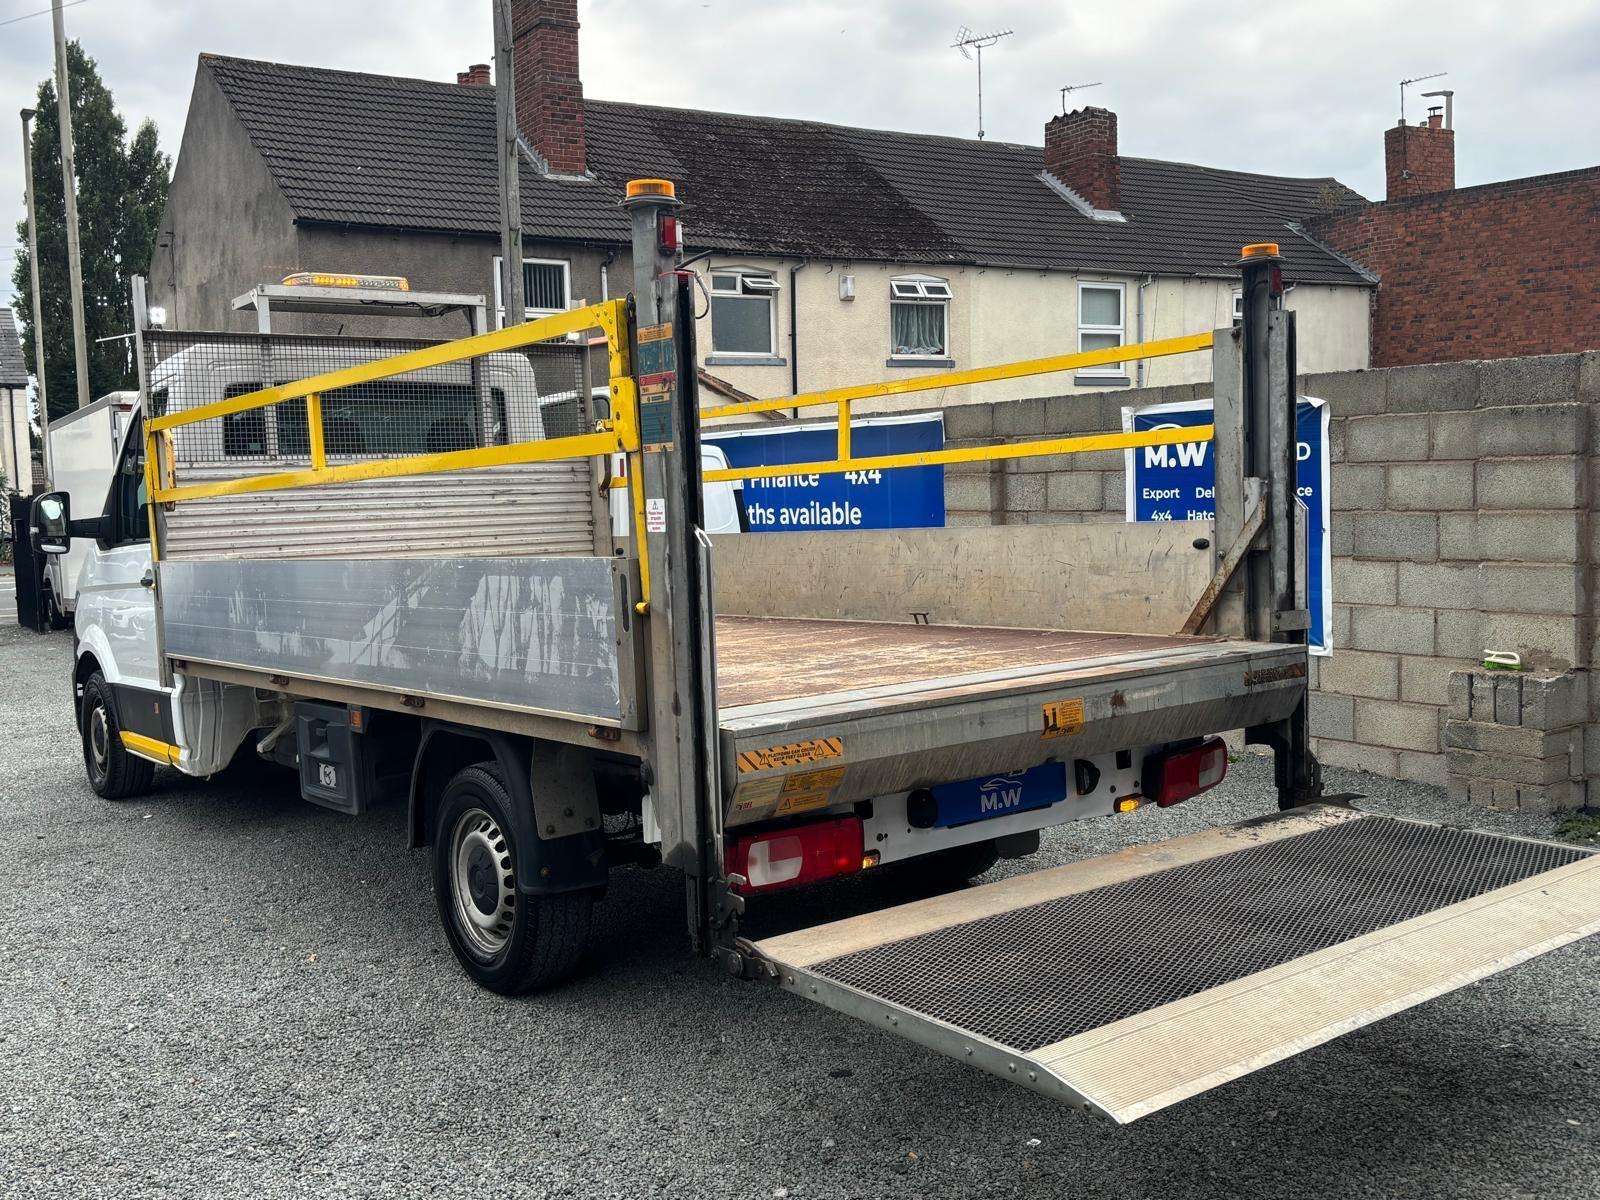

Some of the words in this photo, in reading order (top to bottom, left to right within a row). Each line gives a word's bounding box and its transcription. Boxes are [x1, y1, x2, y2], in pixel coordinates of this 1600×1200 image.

[1145, 440, 1207, 469] M.W
[844, 469, 882, 485] 4x4
[1142, 487, 1180, 501] Export
[746, 502, 775, 525] ths
[779, 500, 862, 525] available
[1151, 509, 1172, 521] 4x4
[981, 788, 1022, 813] M.W
